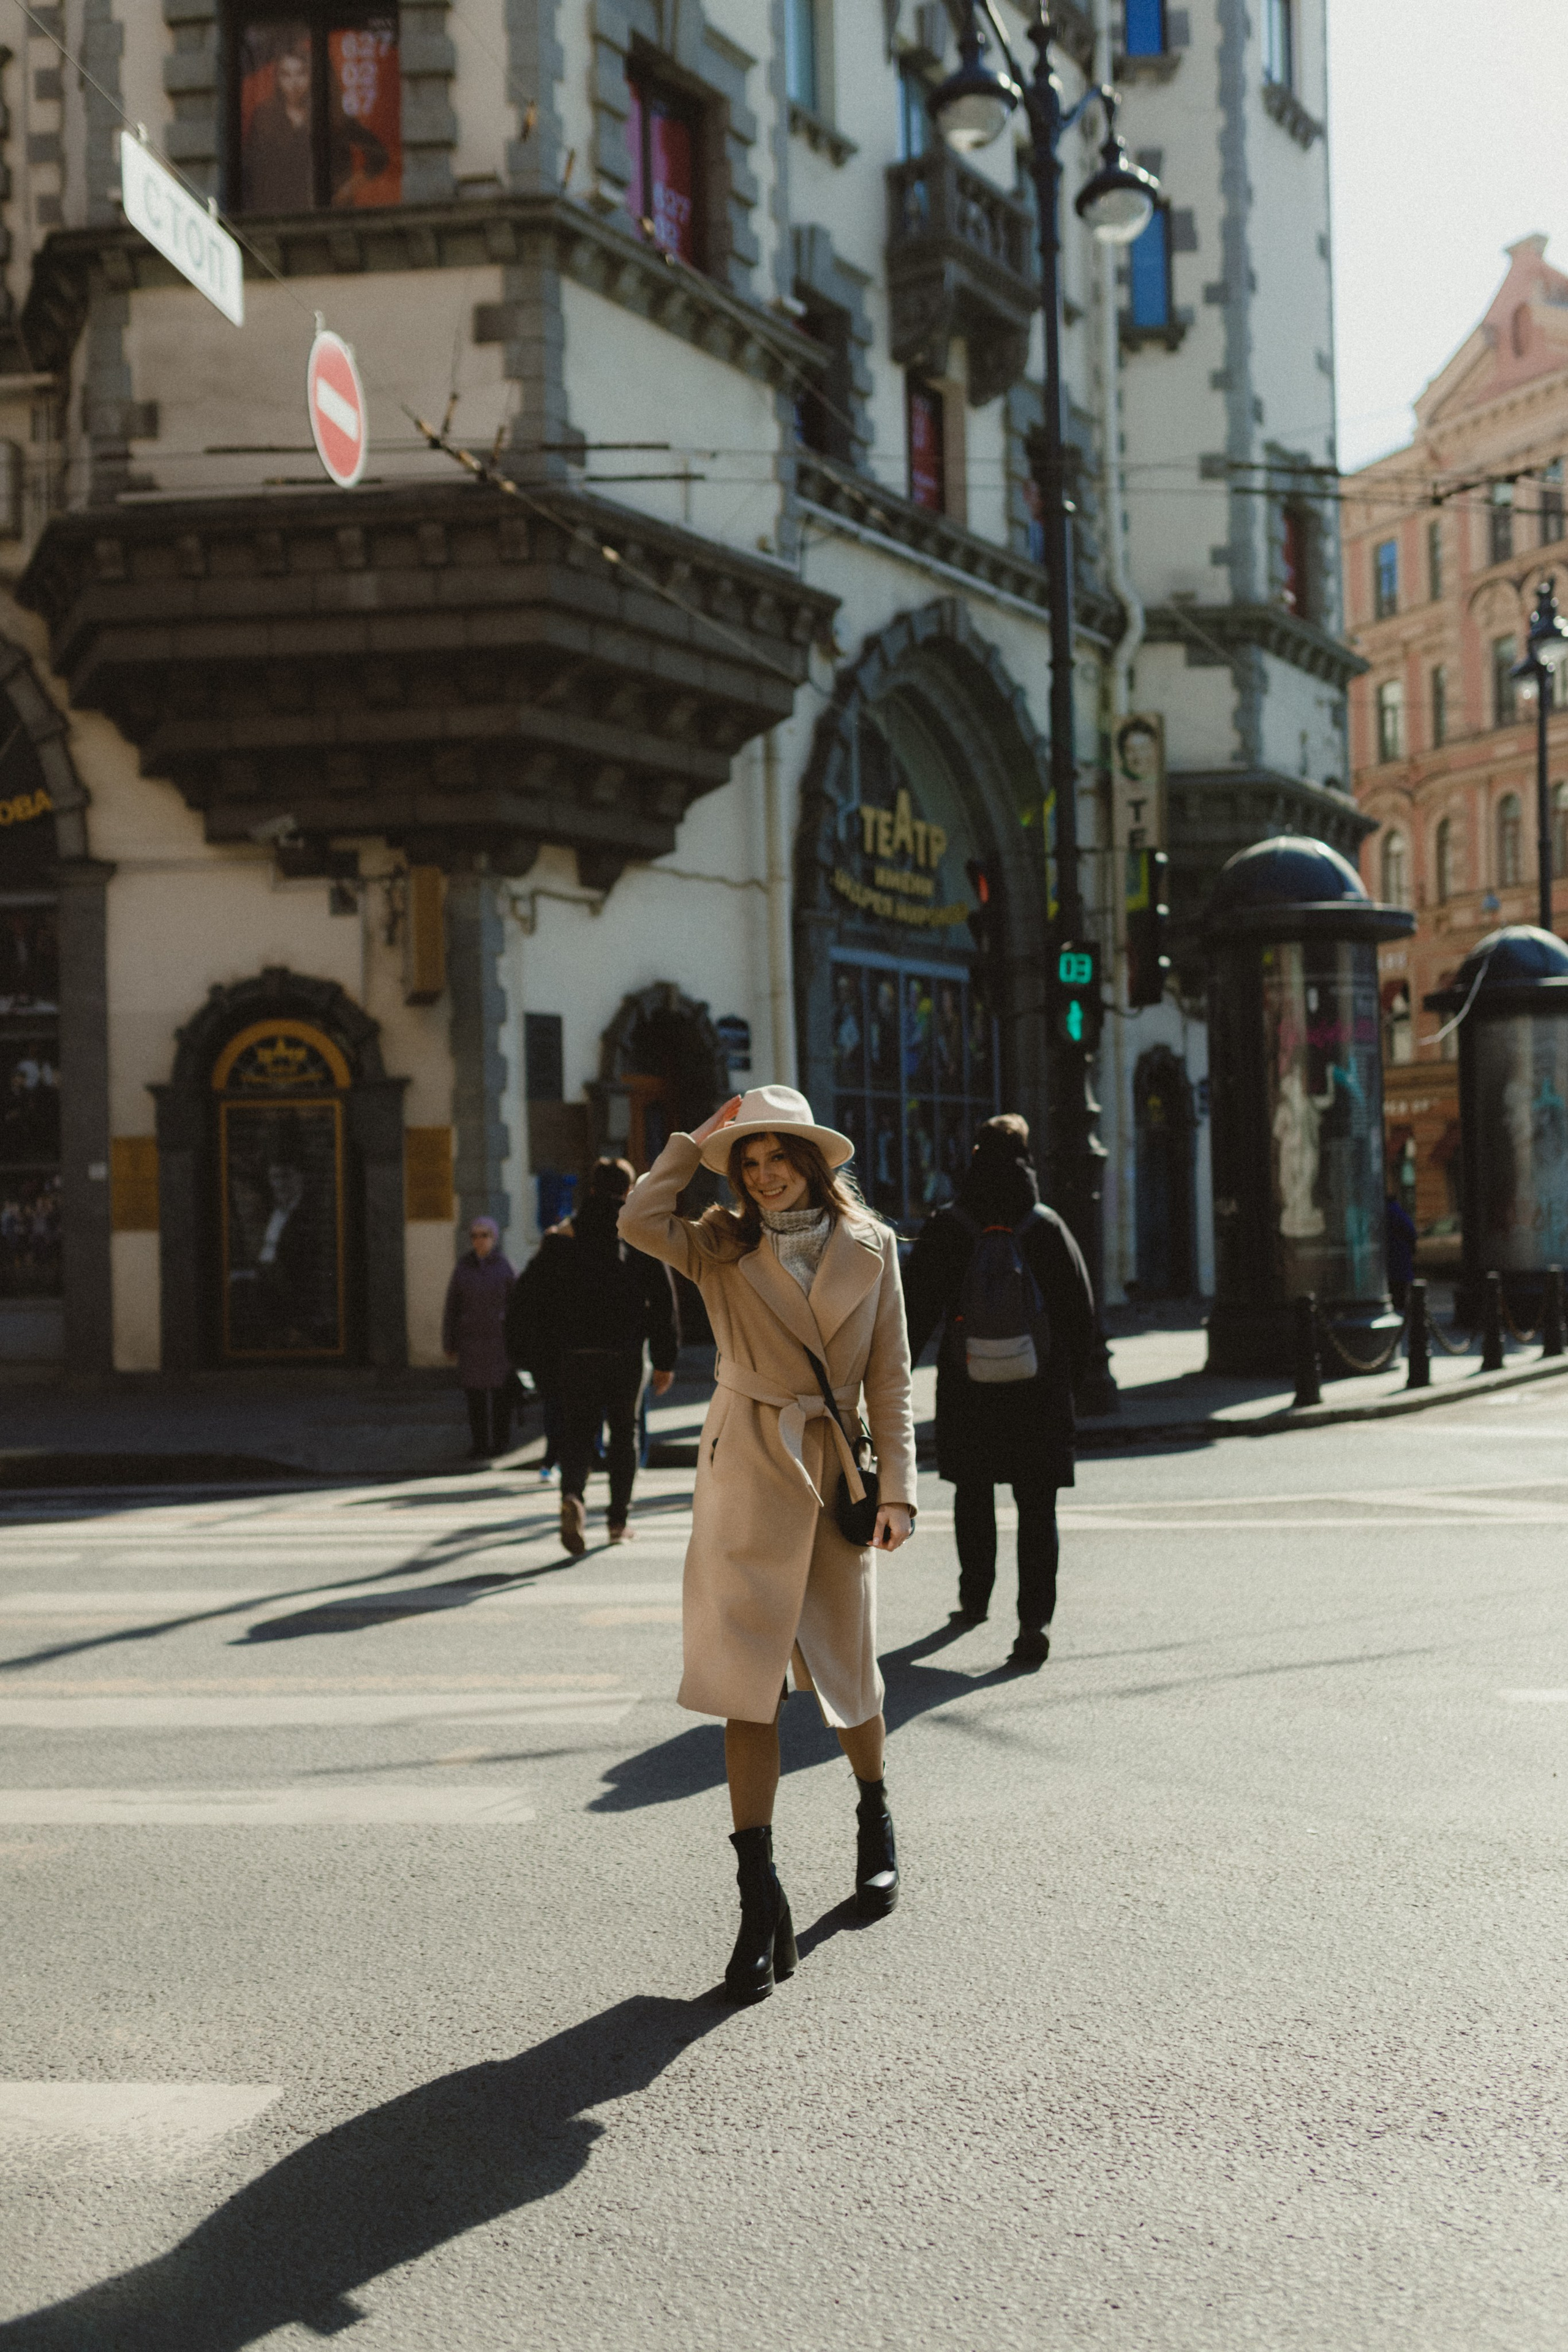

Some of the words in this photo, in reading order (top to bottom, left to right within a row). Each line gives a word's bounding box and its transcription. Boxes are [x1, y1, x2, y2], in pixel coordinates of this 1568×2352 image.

[143, 174, 227, 293] СТОП
[859, 787, 947, 870] ТЕАТР
[1059, 952, 1092, 984] 03
